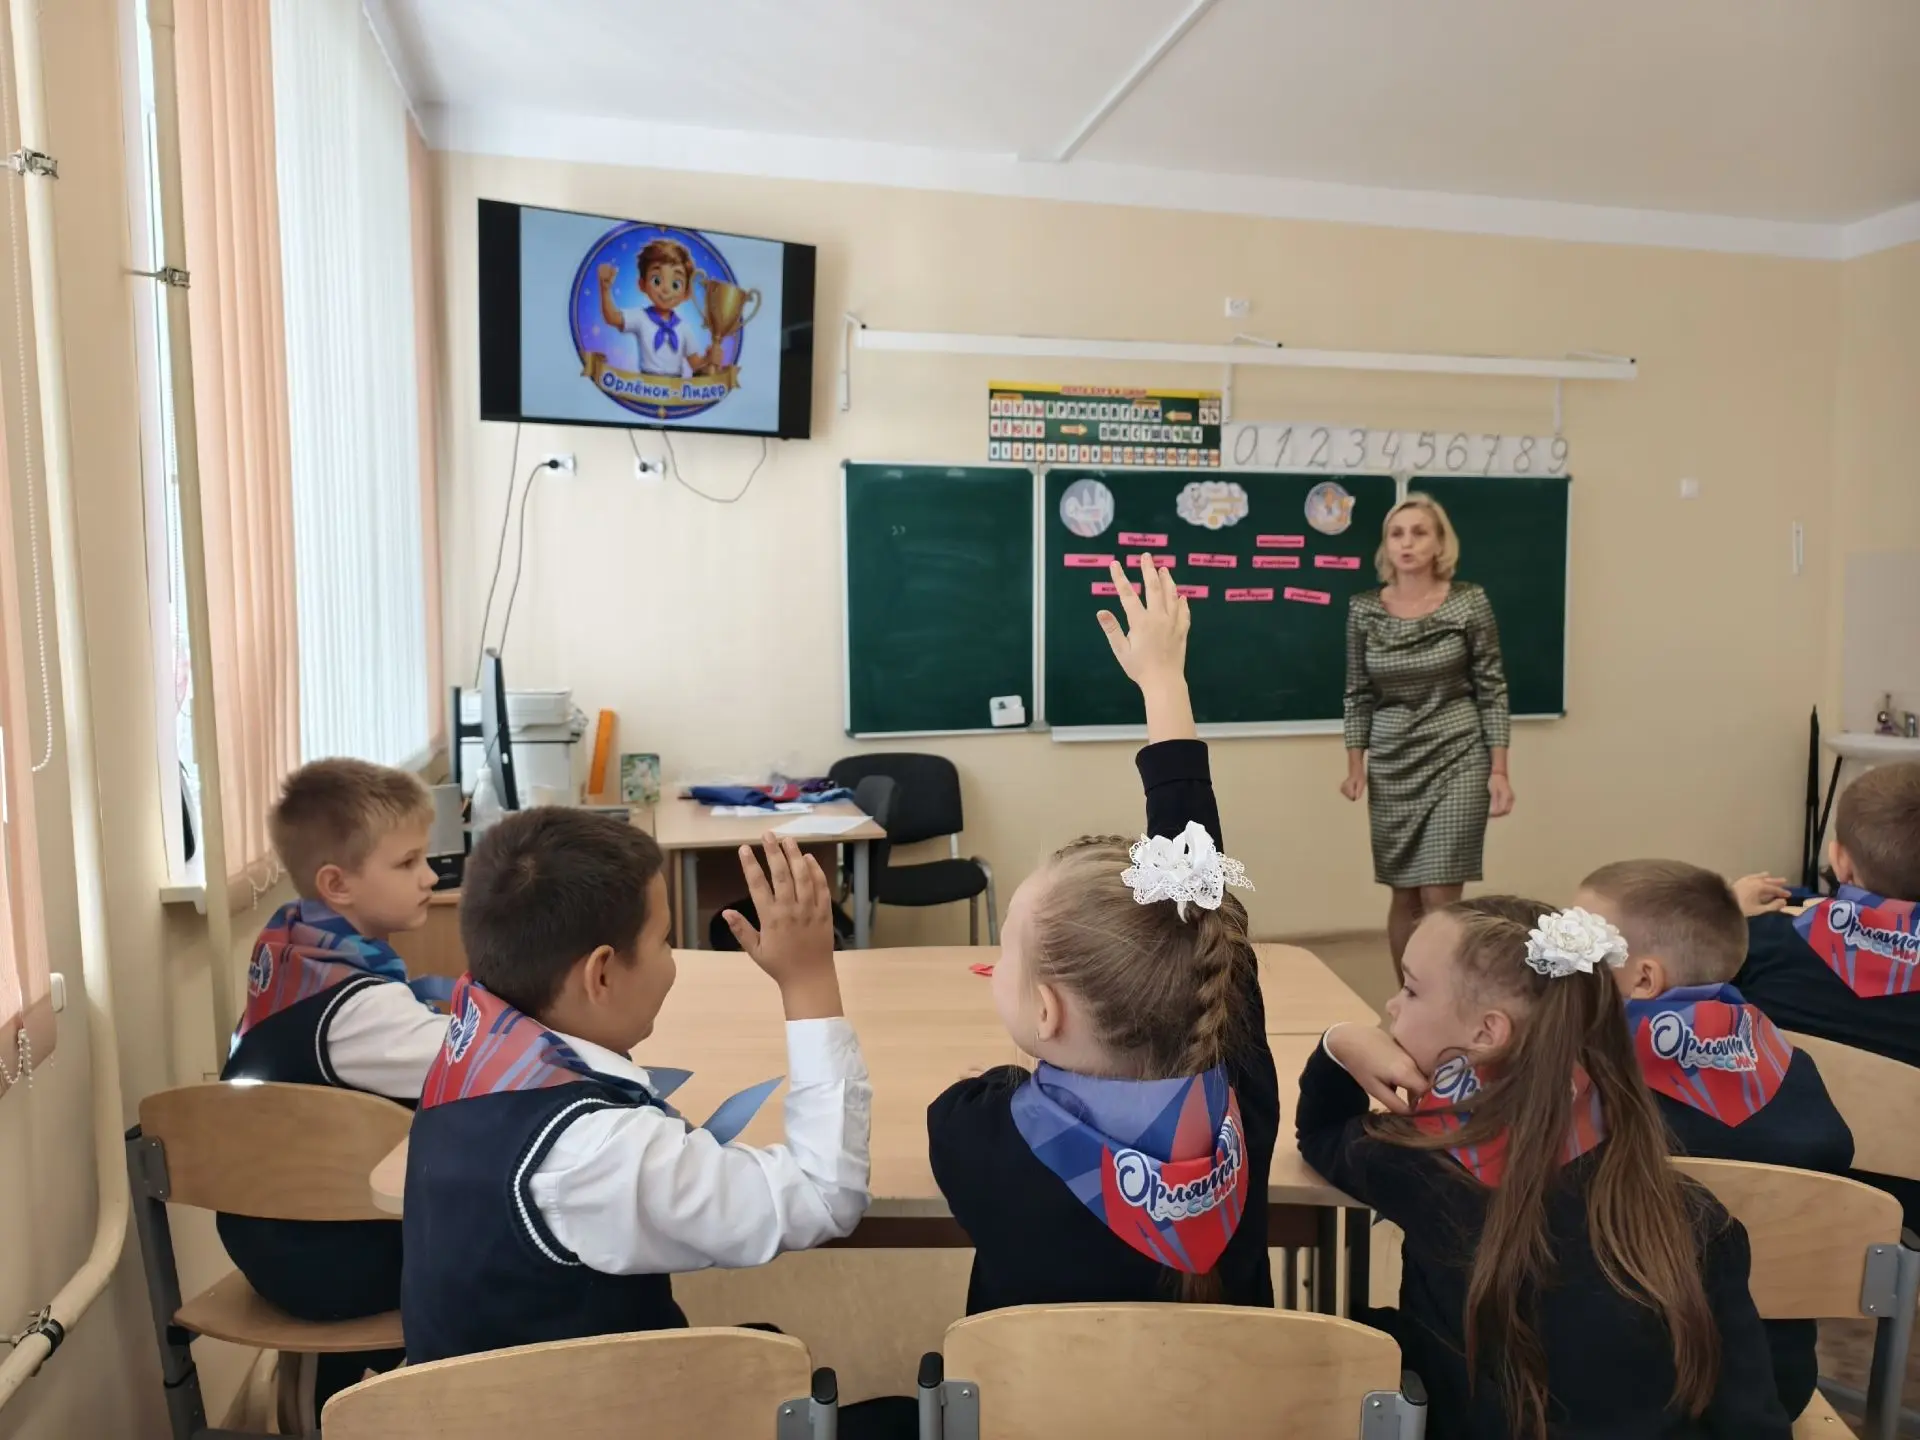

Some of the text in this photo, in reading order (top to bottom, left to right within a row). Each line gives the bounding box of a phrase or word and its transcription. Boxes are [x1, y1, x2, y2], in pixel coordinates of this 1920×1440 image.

[602, 372, 670, 398] Орлёнок
[681, 384, 726, 400] Лидер
[1275, 427, 1292, 469] 1
[1306, 427, 1330, 469] 2
[1343, 428, 1367, 469] 3
[1382, 430, 1400, 470] 4
[1413, 431, 1436, 470] 5
[1445, 432, 1468, 472] 6
[1478, 434, 1501, 475] 7
[1513, 435, 1535, 474] 8
[1547, 435, 1569, 474] 9
[1652, 1013, 1744, 1062] Орлята
[1116, 1150, 1236, 1213] Орлята
